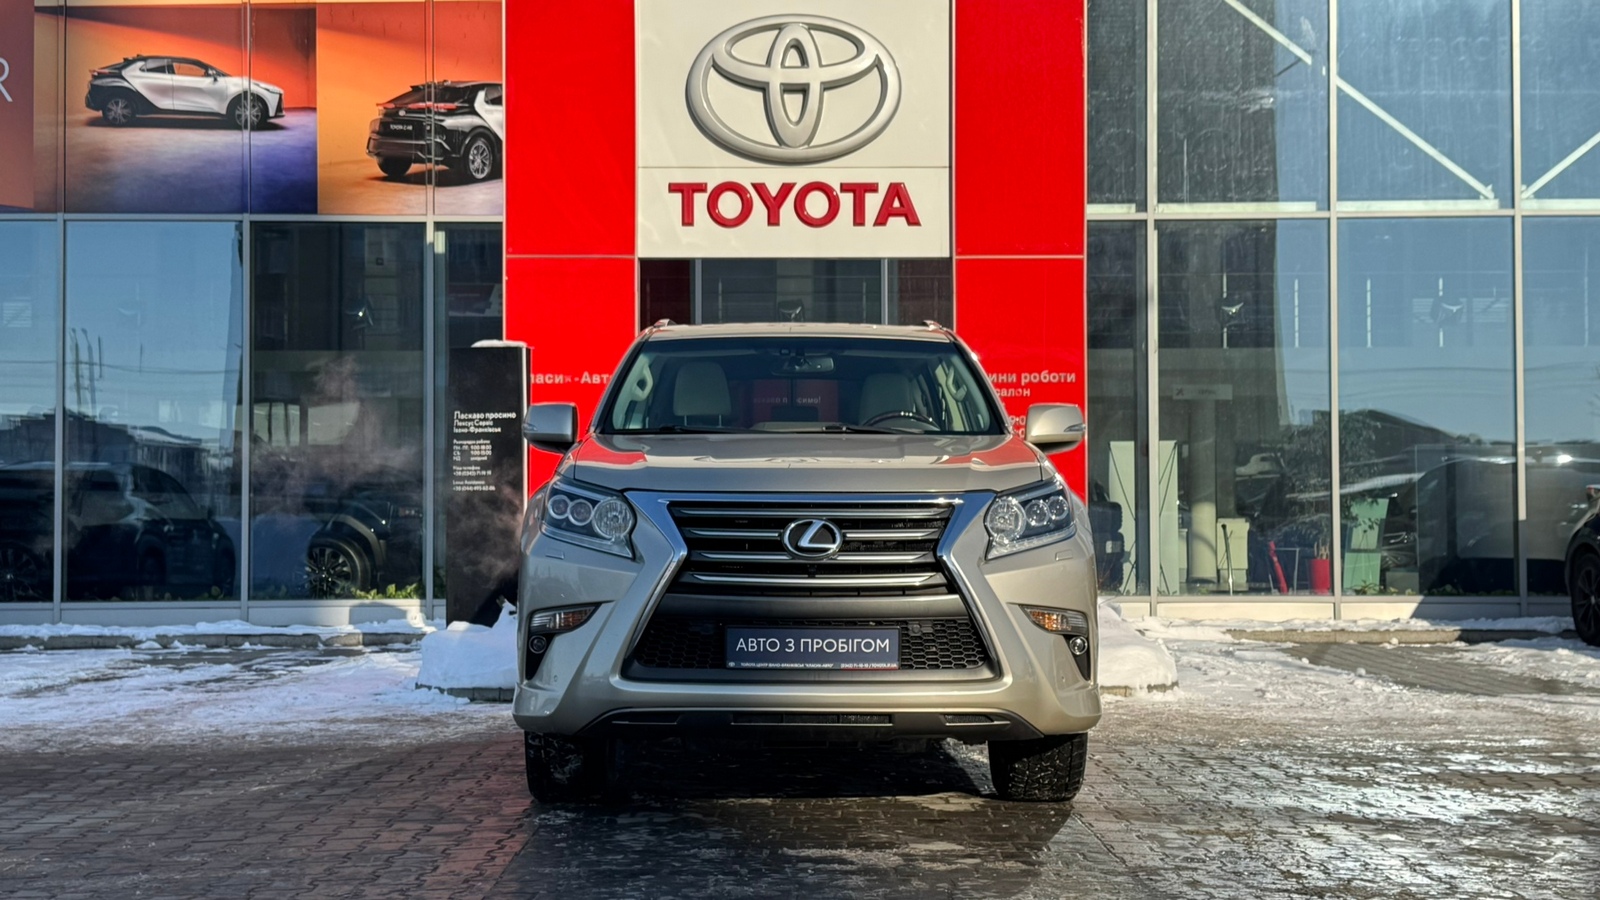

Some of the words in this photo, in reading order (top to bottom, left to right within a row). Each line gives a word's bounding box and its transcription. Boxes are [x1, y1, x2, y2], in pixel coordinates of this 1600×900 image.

[668, 181, 922, 228] TOYOTA
[1021, 370, 1076, 386] роботи
[454, 411, 485, 420] Ласкаво
[485, 412, 517, 420] просимо
[736, 638, 780, 652] АВТО
[785, 638, 795, 652] З
[800, 638, 890, 653] ПРОБІГОМ
